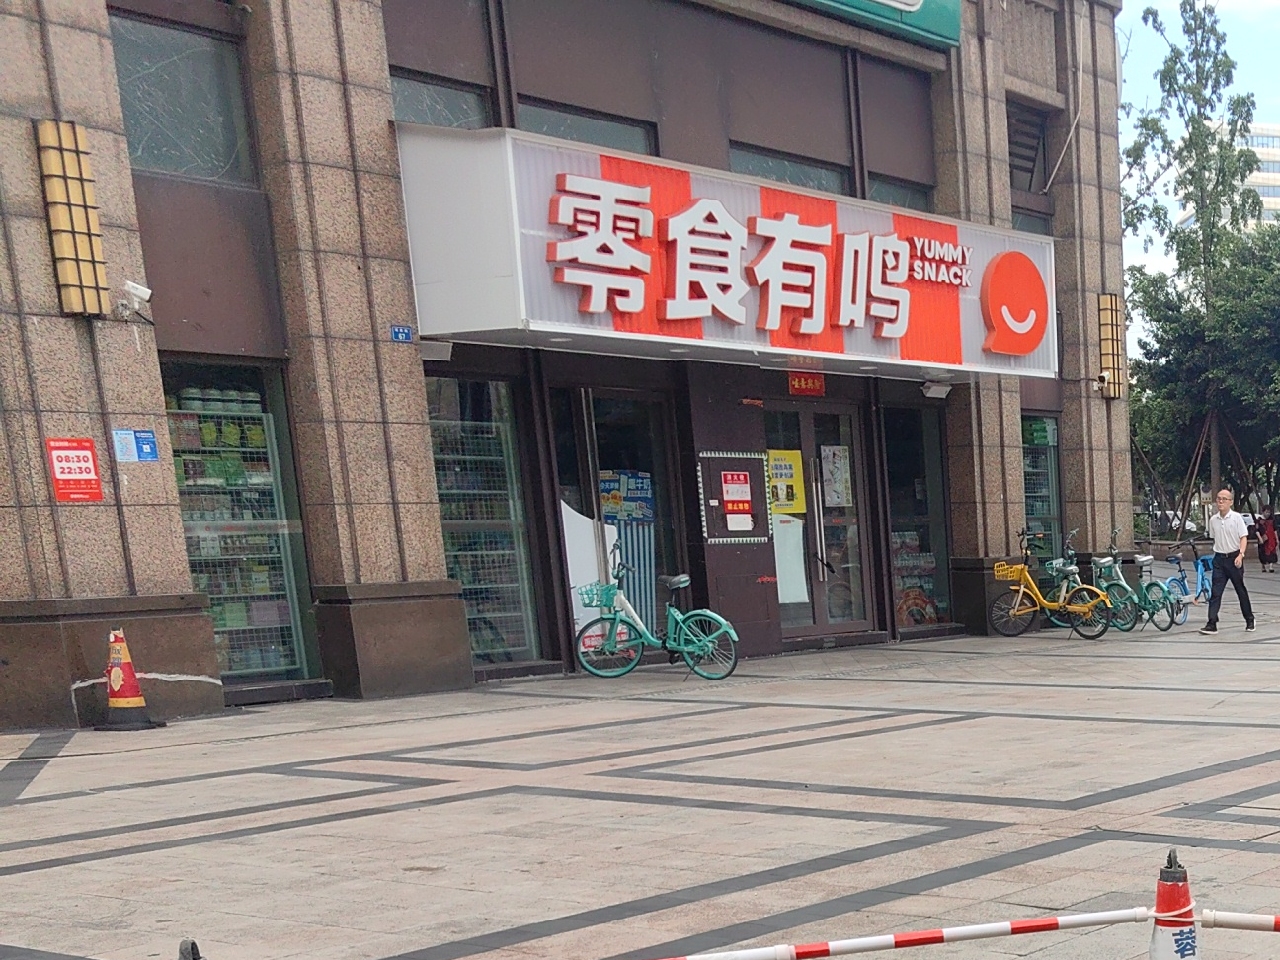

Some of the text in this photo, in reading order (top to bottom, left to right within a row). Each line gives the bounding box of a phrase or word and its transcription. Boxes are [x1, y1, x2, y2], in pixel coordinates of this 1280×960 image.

[548, 173, 910, 338] 零食有鸣
[913, 236, 973, 265] YUMMY
[913, 260, 972, 287] SNACK
[56, 455, 90, 463] 08:30
[59, 466, 92, 475] 22:30
